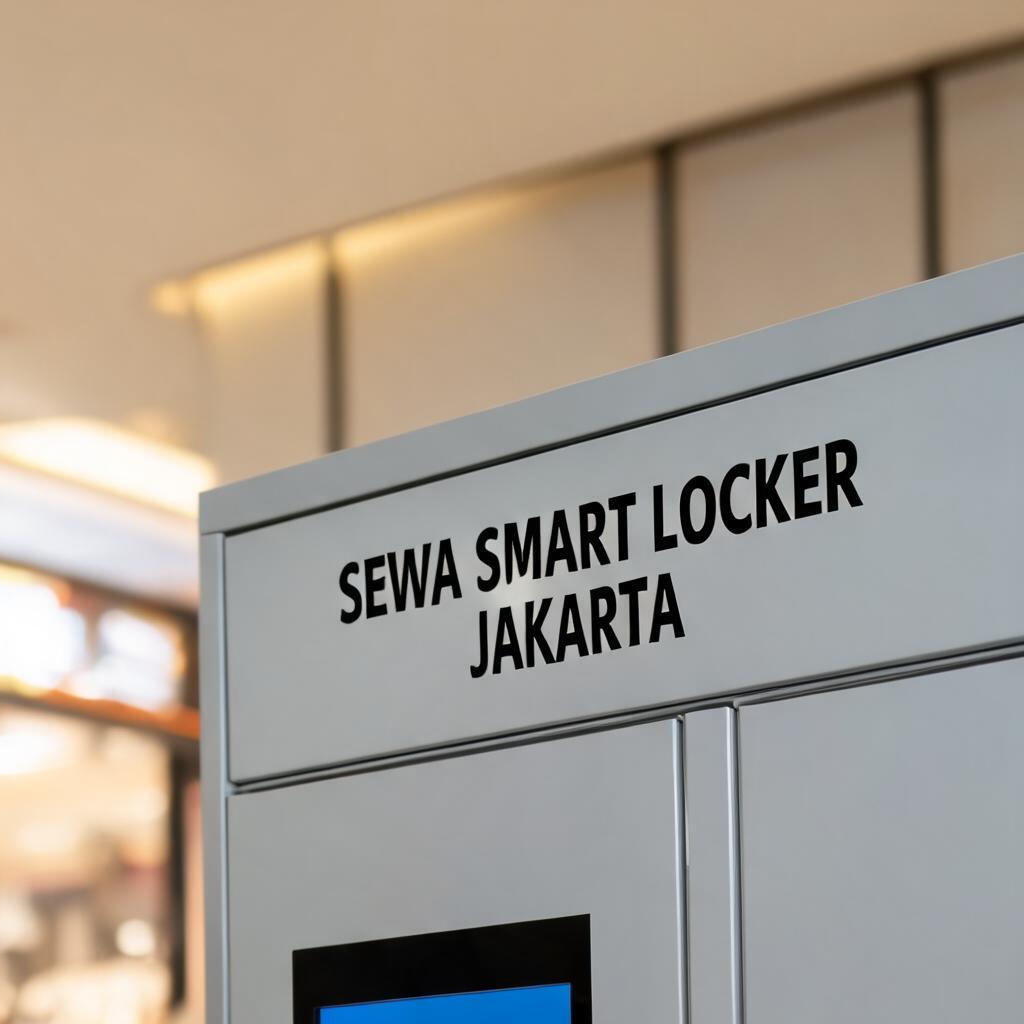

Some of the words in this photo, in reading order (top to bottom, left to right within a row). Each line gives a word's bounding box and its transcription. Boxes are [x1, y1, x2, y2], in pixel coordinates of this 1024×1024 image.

[338, 537, 463, 625] SEWA
[475, 491, 637, 593] SMART
[652, 438, 864, 553] LOCKER
[469, 572, 686, 679] JAKARTA
